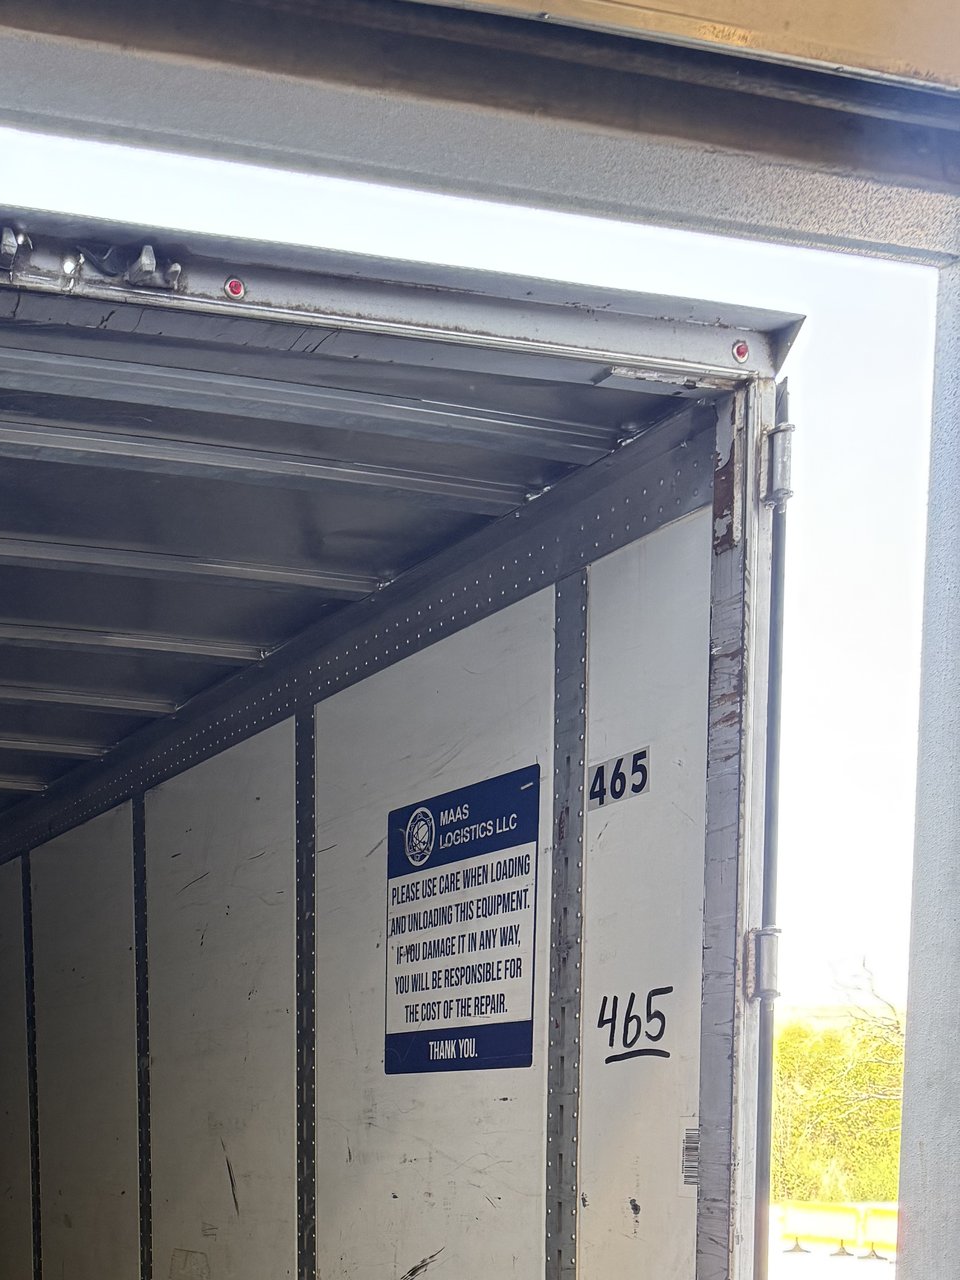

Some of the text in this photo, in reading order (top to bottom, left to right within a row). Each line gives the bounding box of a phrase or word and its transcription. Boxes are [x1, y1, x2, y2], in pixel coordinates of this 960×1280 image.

[590, 749, 648, 805] 465
[439, 813, 517, 849] LOGISTICS LLC
[440, 804, 469, 826] MAAS
[392, 854, 531, 906] PLEASE USE CARE WHEN LOADING
[390, 889, 530, 936] AND UNLOADING THIS EQUIPMENT.
[396, 924, 521, 965] IF YOU DAMAGE IT IN ANY WAY,
[395, 957, 522, 995] YOU WILL BE RESPONSIBLE FOR
[405, 993, 508, 1023] THE COST OF THE REPAIR.
[597, 986, 674, 1048] 465
[429, 1038, 478, 1060] THANK YOU.
